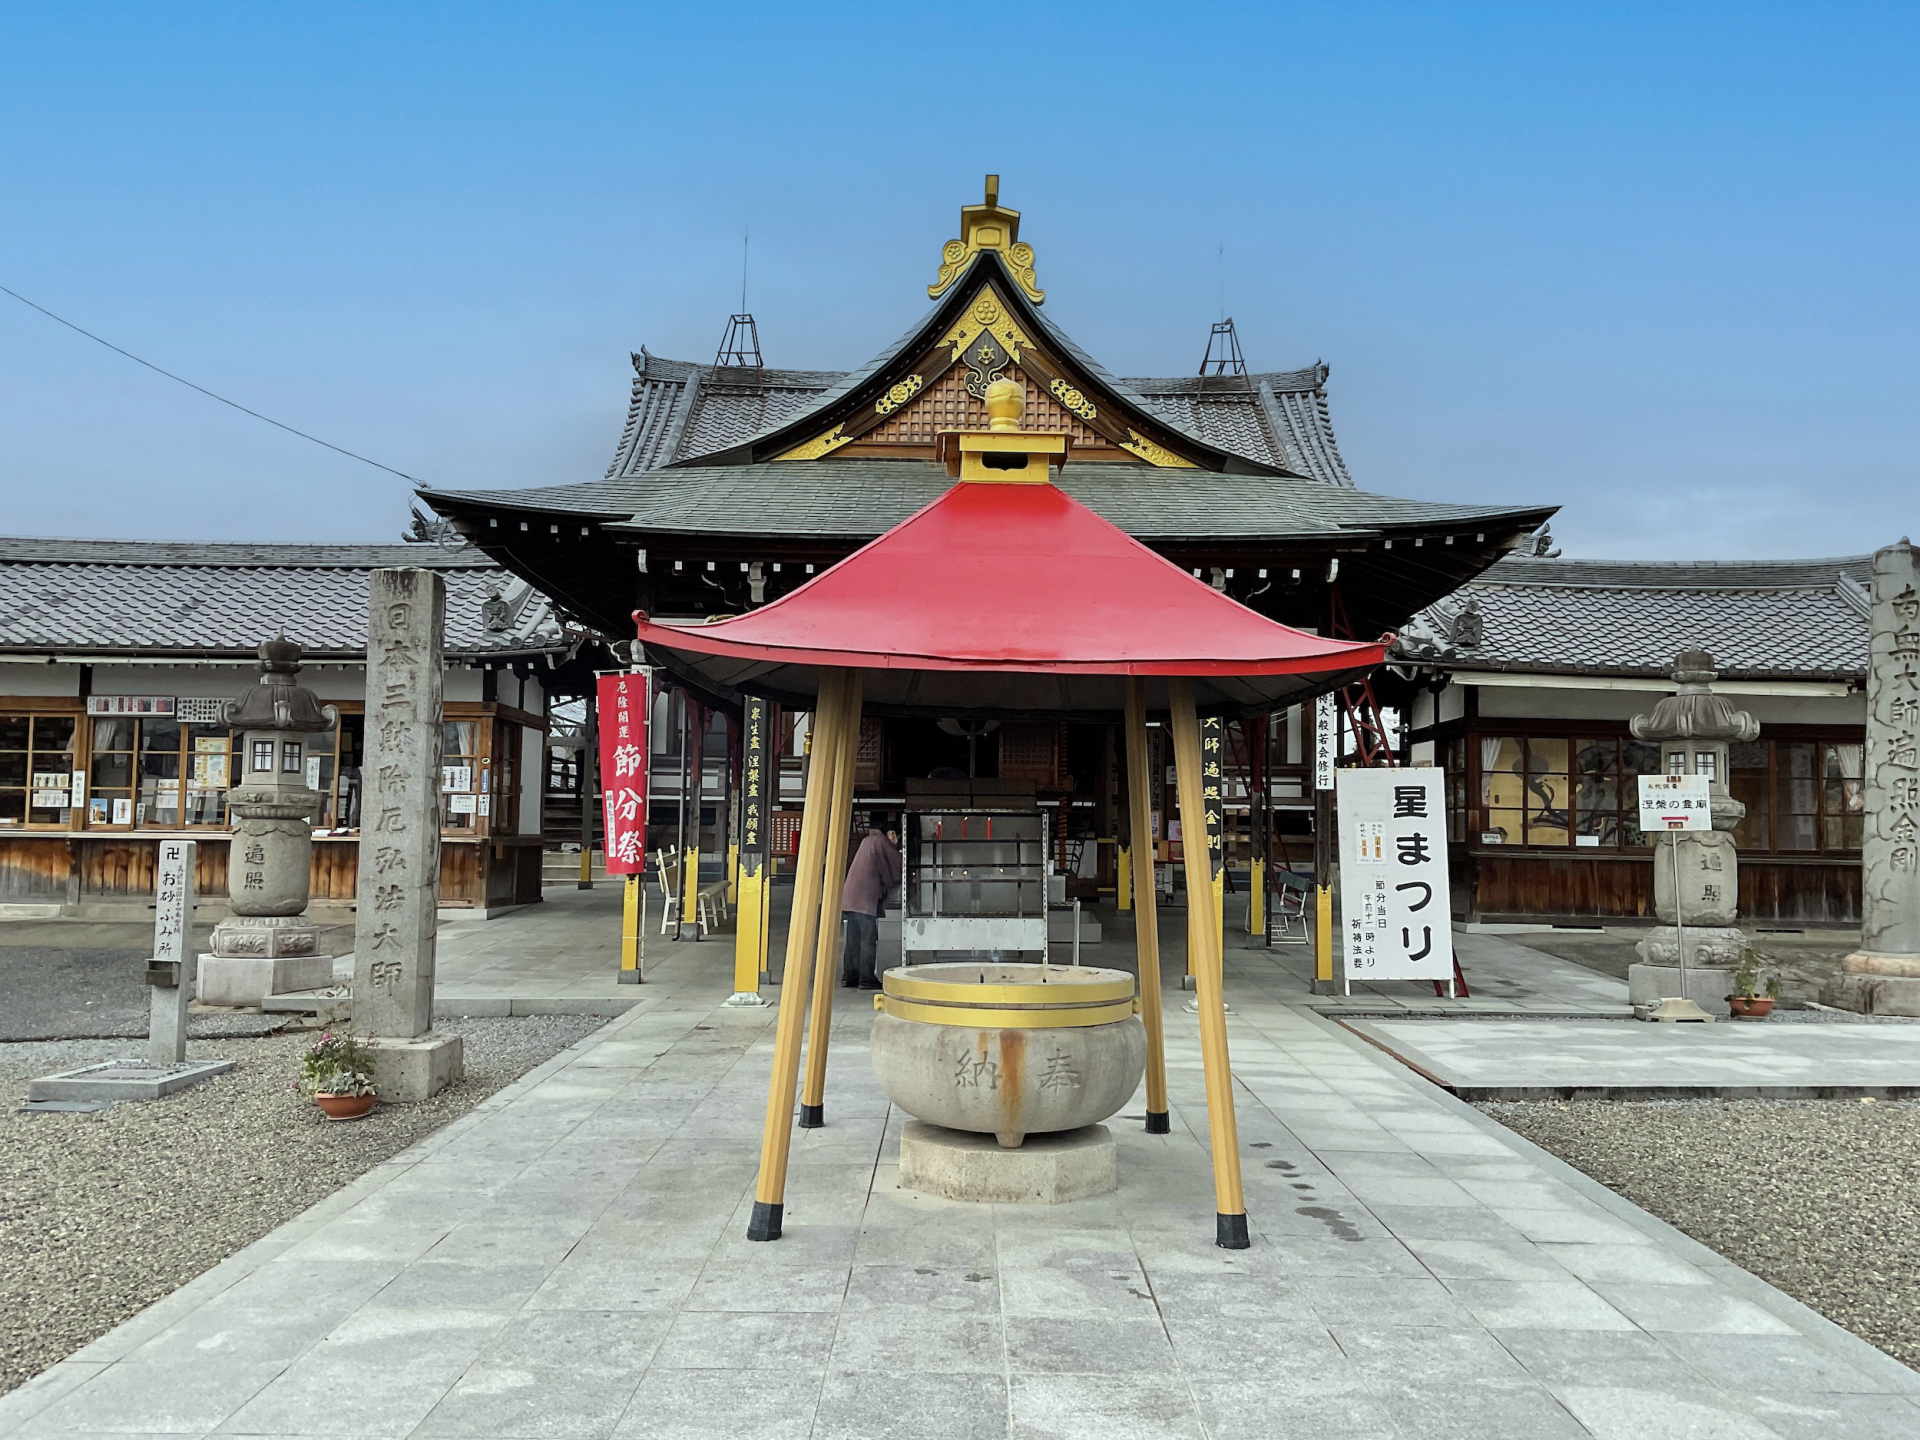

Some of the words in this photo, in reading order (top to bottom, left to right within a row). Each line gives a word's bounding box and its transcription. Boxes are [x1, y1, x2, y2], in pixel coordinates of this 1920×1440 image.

[616, 680, 630, 738] 厄除開運
[612, 743, 643, 865] 節分祭
[1642, 799, 1707, 809] 涅槃の霊廟
[1375, 880, 1387, 929] 節分当日
[1393, 785, 1432, 962] 星まつり
[158, 870, 177, 957] お砂ふみ所
